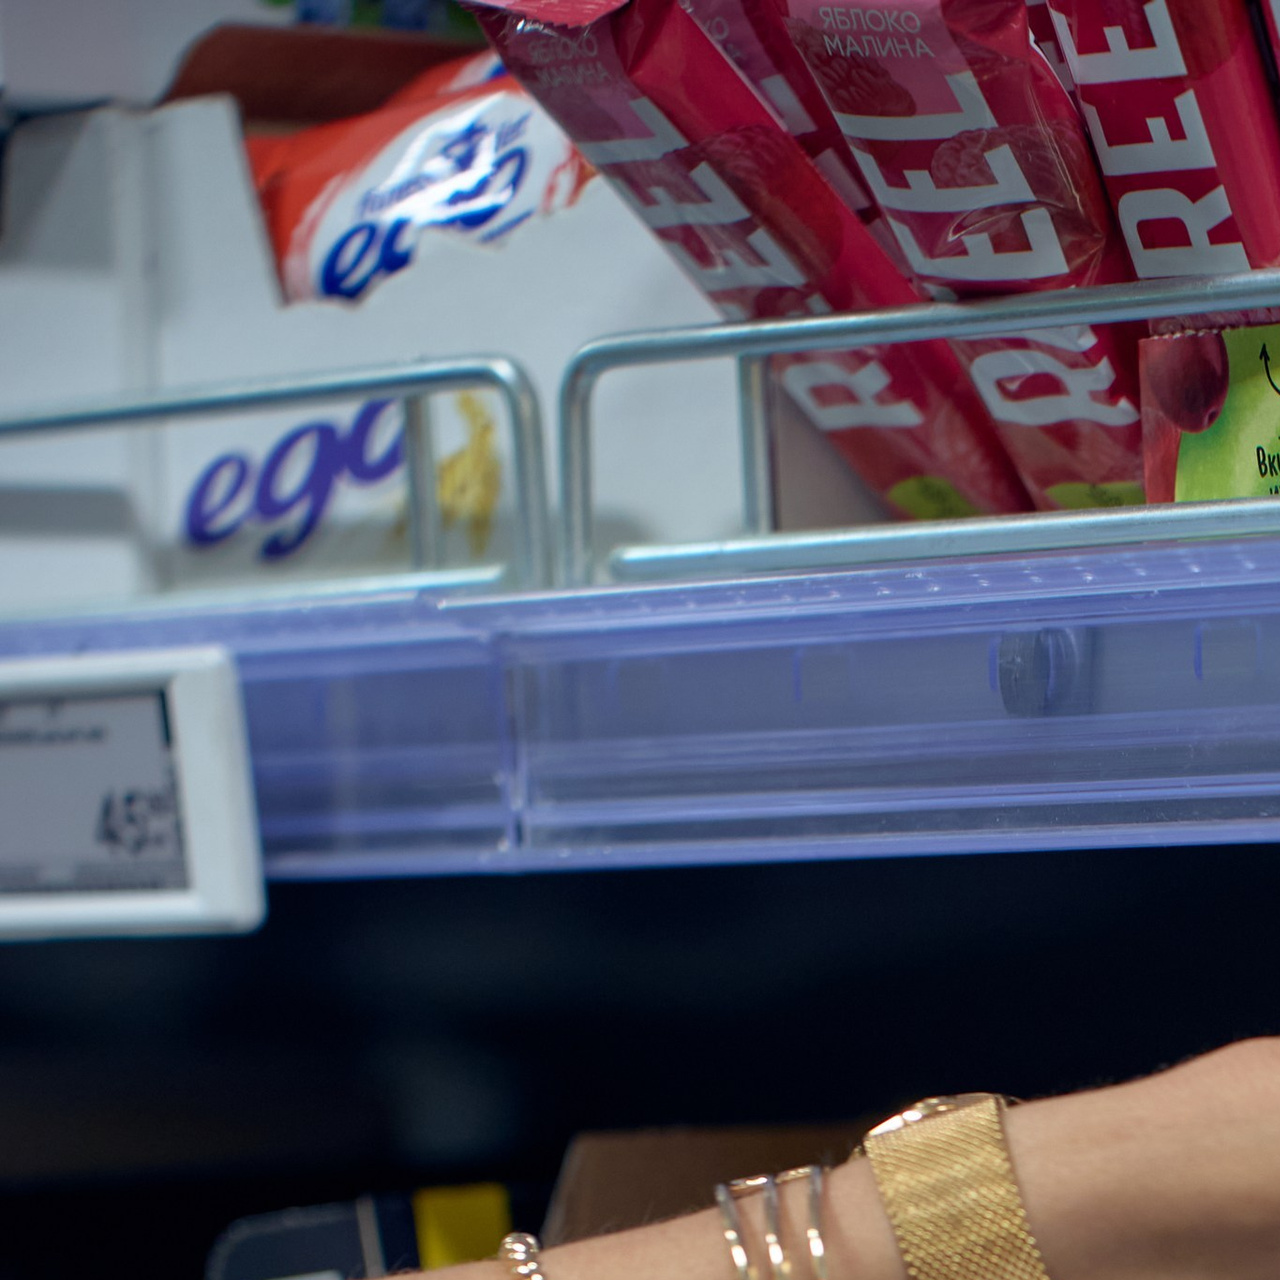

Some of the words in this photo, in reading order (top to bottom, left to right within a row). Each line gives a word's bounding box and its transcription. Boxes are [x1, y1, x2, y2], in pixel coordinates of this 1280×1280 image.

[819, 7, 921, 36] ЯБЛОКО
[823, 34, 934, 60] МАЛИНА
[184, 394, 412, 563] ego
